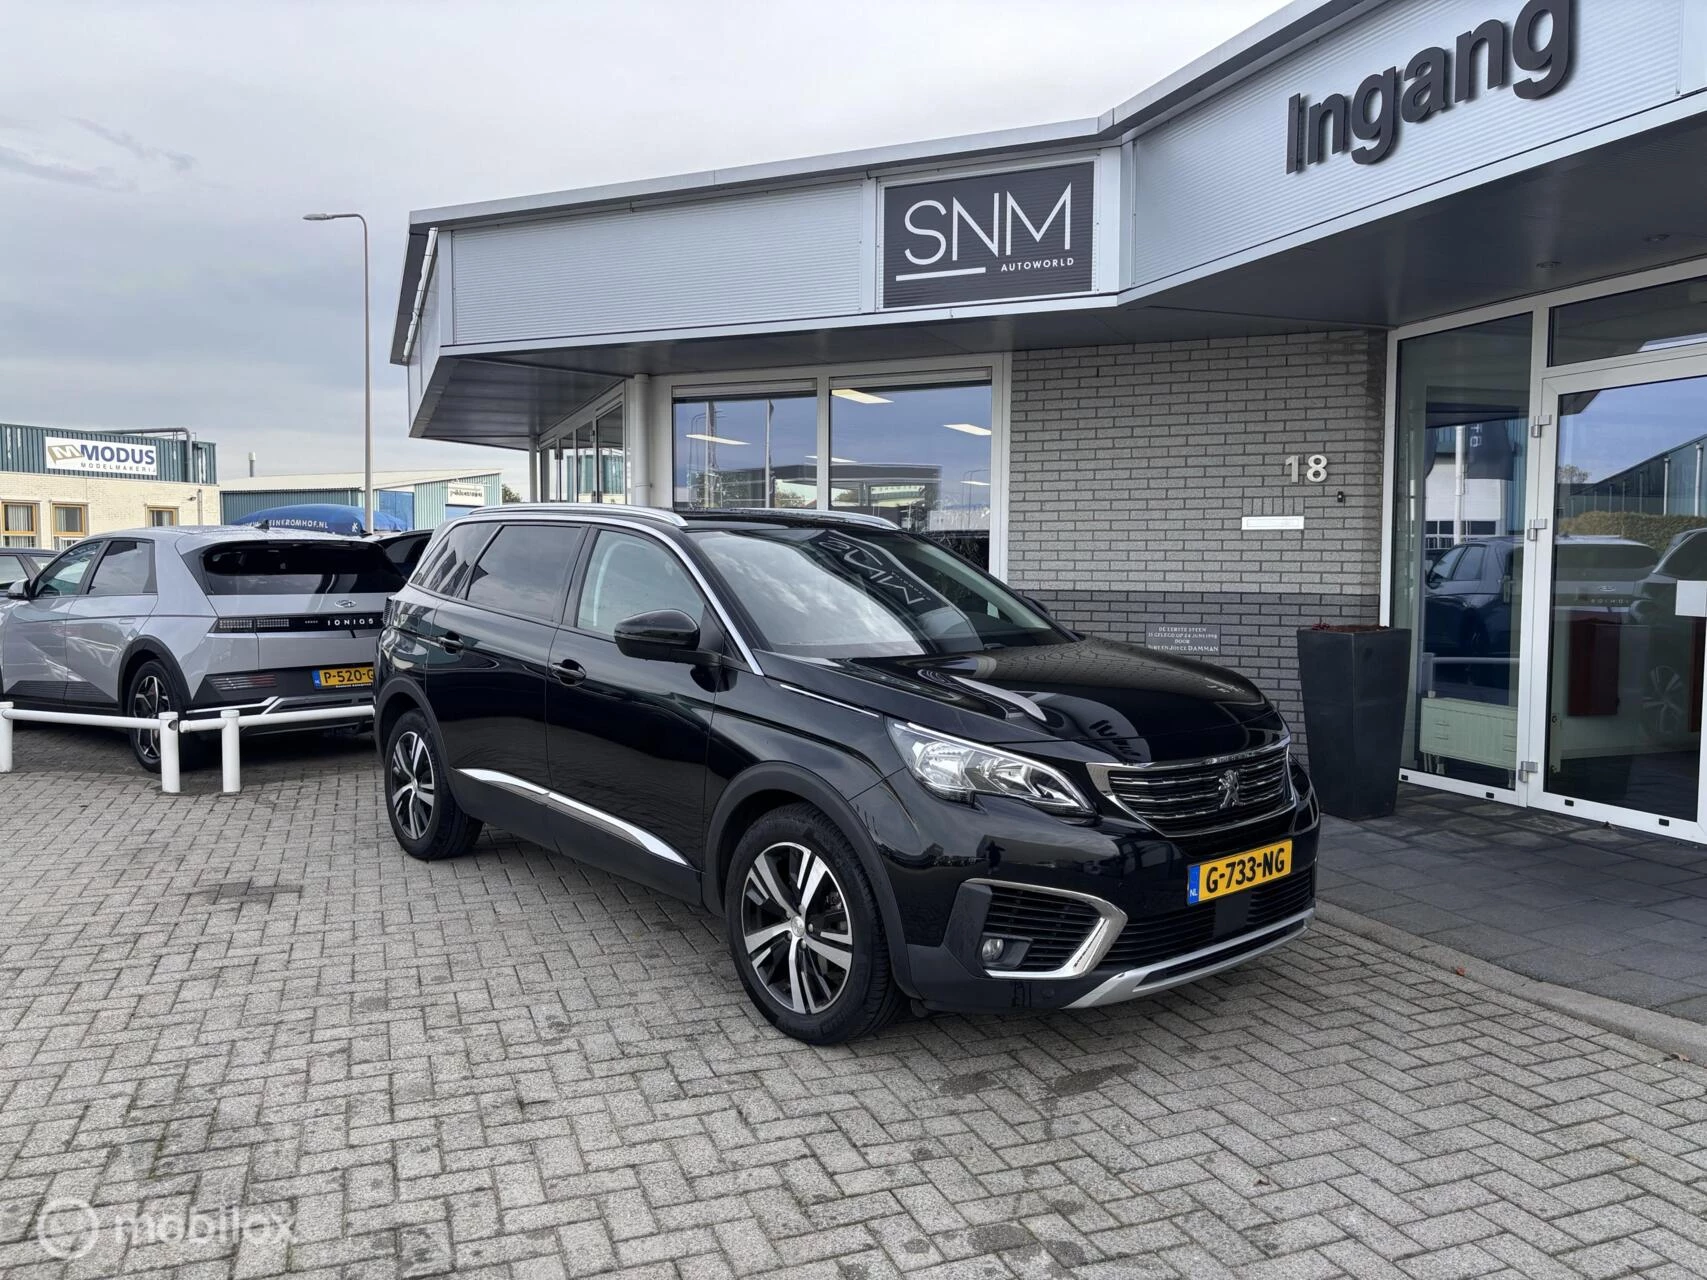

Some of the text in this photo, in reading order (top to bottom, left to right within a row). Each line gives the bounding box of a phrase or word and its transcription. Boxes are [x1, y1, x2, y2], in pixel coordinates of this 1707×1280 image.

[1286, 0, 1576, 175] Ingang
[904, 182, 1072, 265] SNM
[1001, 257, 1074, 272] AUTOWORLD
[80, 444, 155, 465] MODUS
[80, 462, 156, 473] MODELMAKERIJ
[1285, 454, 1328, 482] 18
[1206, 848, 1285, 894] G-733-NG
